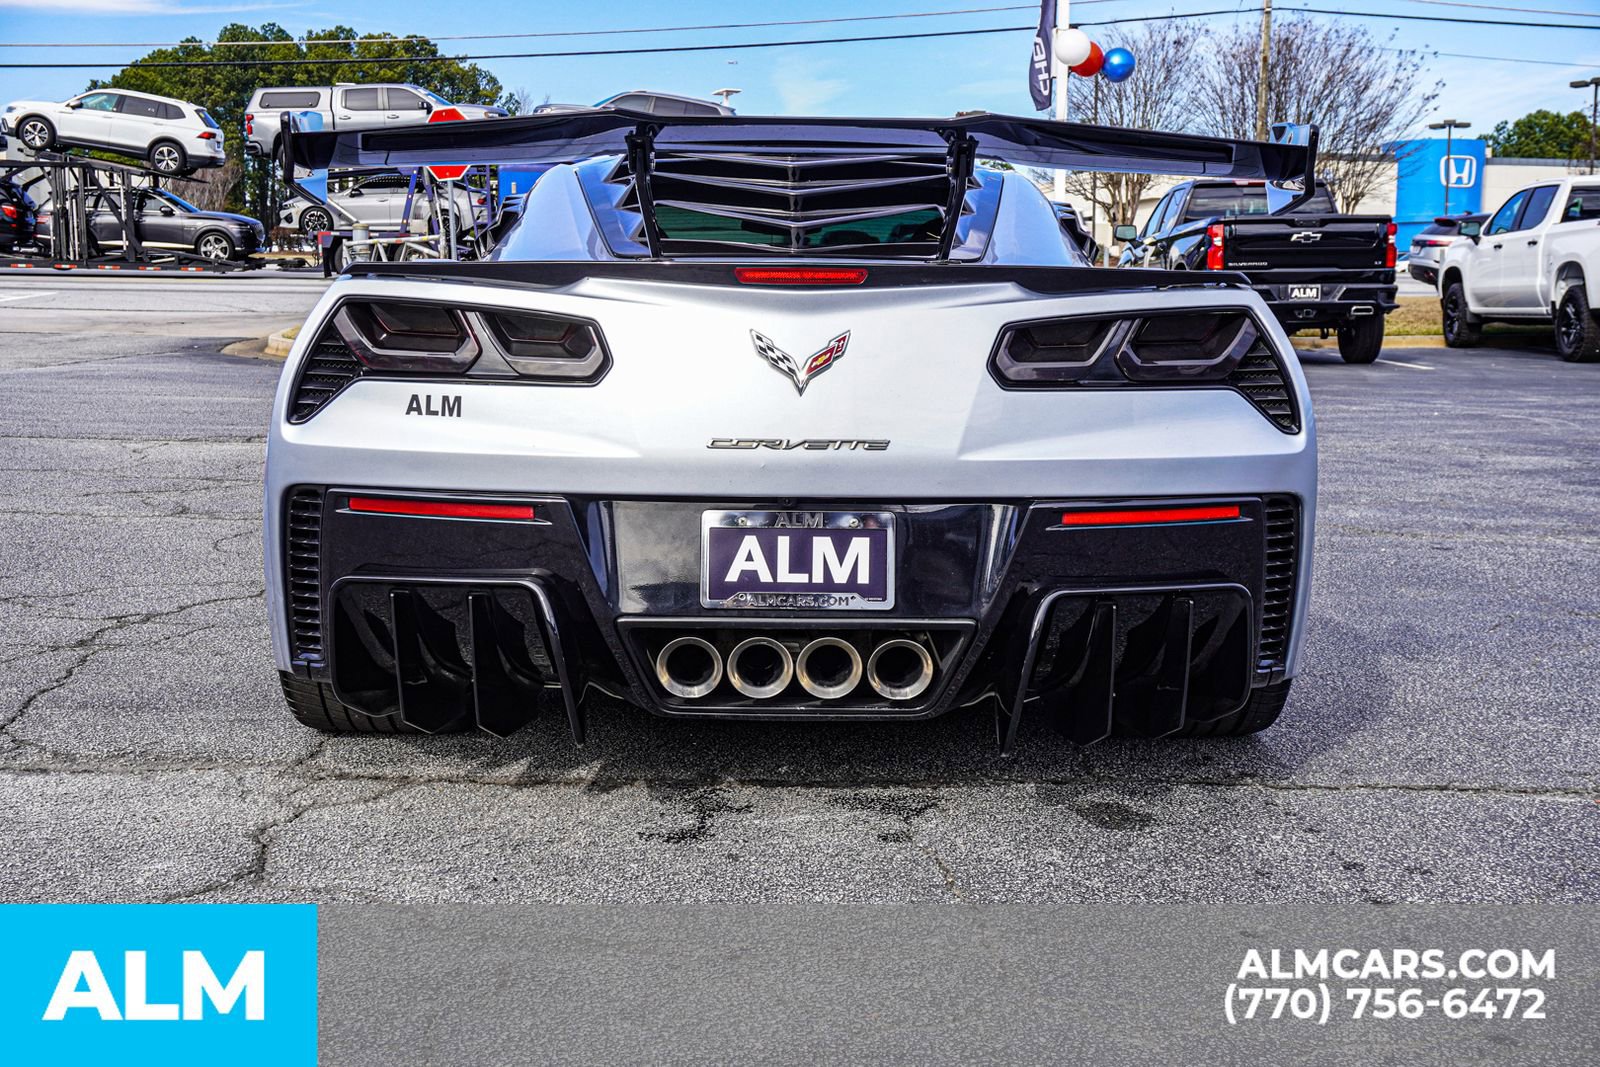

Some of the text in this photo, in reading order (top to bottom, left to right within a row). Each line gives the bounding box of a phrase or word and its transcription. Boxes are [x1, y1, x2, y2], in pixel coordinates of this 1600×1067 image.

[1291, 288, 1317, 298] ALM
[405, 394, 462, 418] ALM
[706, 438, 891, 451] CORVETTE
[774, 512, 824, 528] ALM
[724, 535, 870, 584] ALM
[748, 595, 849, 607] ALMCARS.COM
